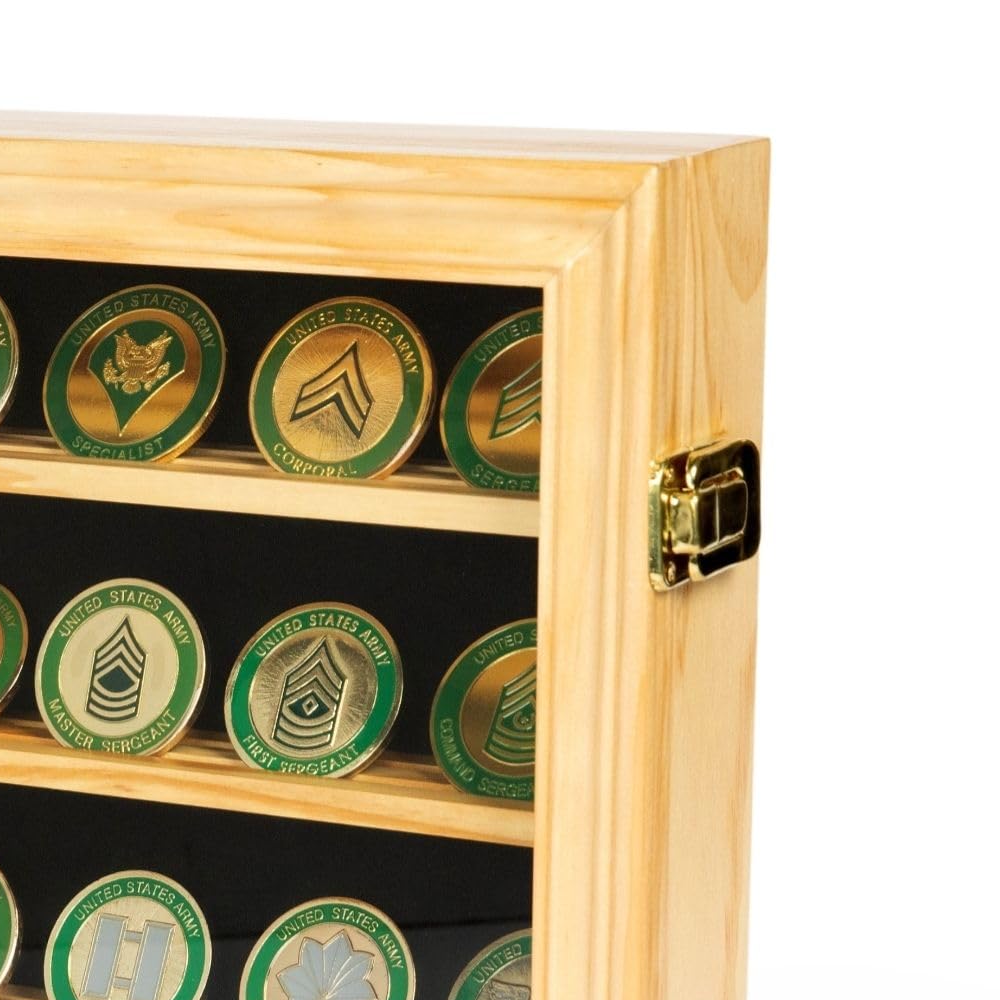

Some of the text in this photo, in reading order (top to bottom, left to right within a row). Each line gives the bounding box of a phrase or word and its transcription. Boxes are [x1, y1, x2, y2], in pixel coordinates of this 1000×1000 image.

[72, 293, 215, 348] UNITED STATES ARMY
[287, 308, 418, 374] UNITED STATES ARMY
[473, 320, 530, 362] UNITED
[72, 435, 164, 460] SPECIALIST
[471, 464, 541, 492] SERGE
[59, 590, 191, 644] UNITED STATES ARMY
[256, 613, 390, 666] UNITED STATES ARMY
[473, 631, 524, 664] UNITED
[49, 698, 176, 753] MASTER SERGEANT
[440, 718, 475, 782] COMMAND
[242, 734, 360, 775] FIRST SERGEANT
[74, 881, 200, 938] UNITED STATES ARMY
[276, 908, 404, 969] UNITED STATES ARMY
[473, 943, 522, 983] UNITED
